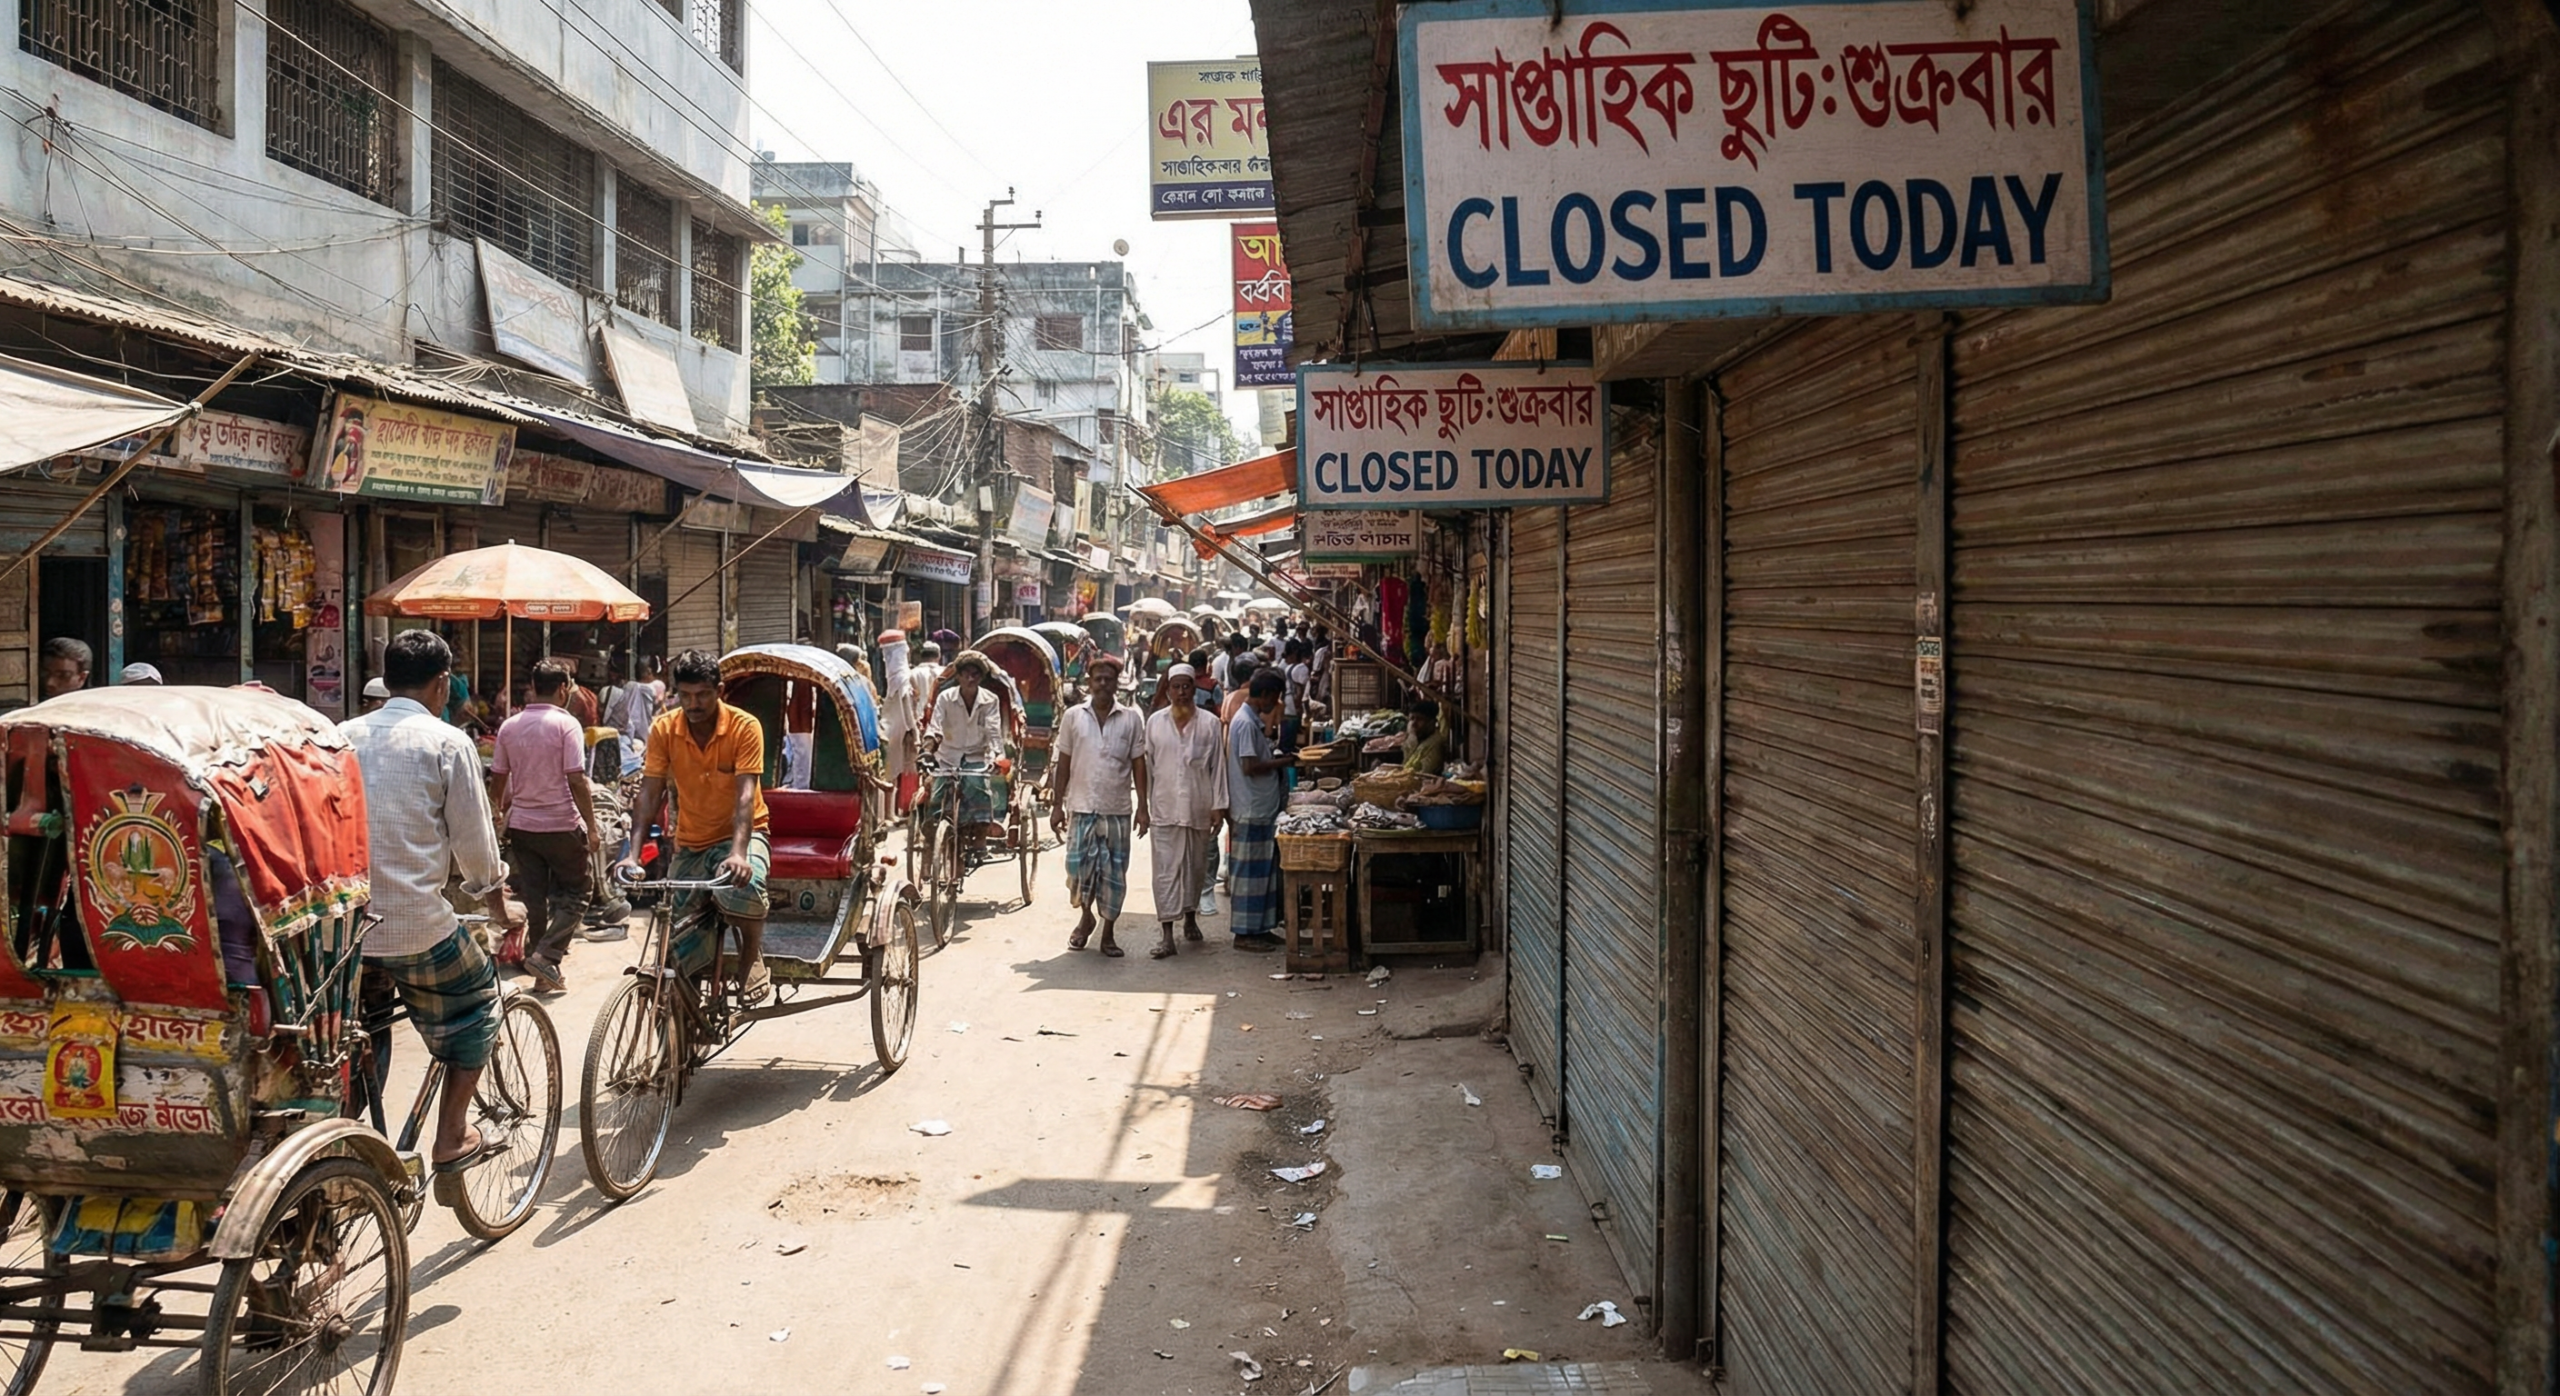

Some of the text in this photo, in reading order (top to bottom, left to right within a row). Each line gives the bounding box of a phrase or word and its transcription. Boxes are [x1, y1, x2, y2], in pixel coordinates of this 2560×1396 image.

[1436, 21, 1696, 156] সাপ্তাহিক
[1446, 172, 2063, 289] CLOSED TODAY
[1312, 374, 1428, 436] সাপ্তাহিক
[1315, 447, 1592, 493] CLOSED TODAY
